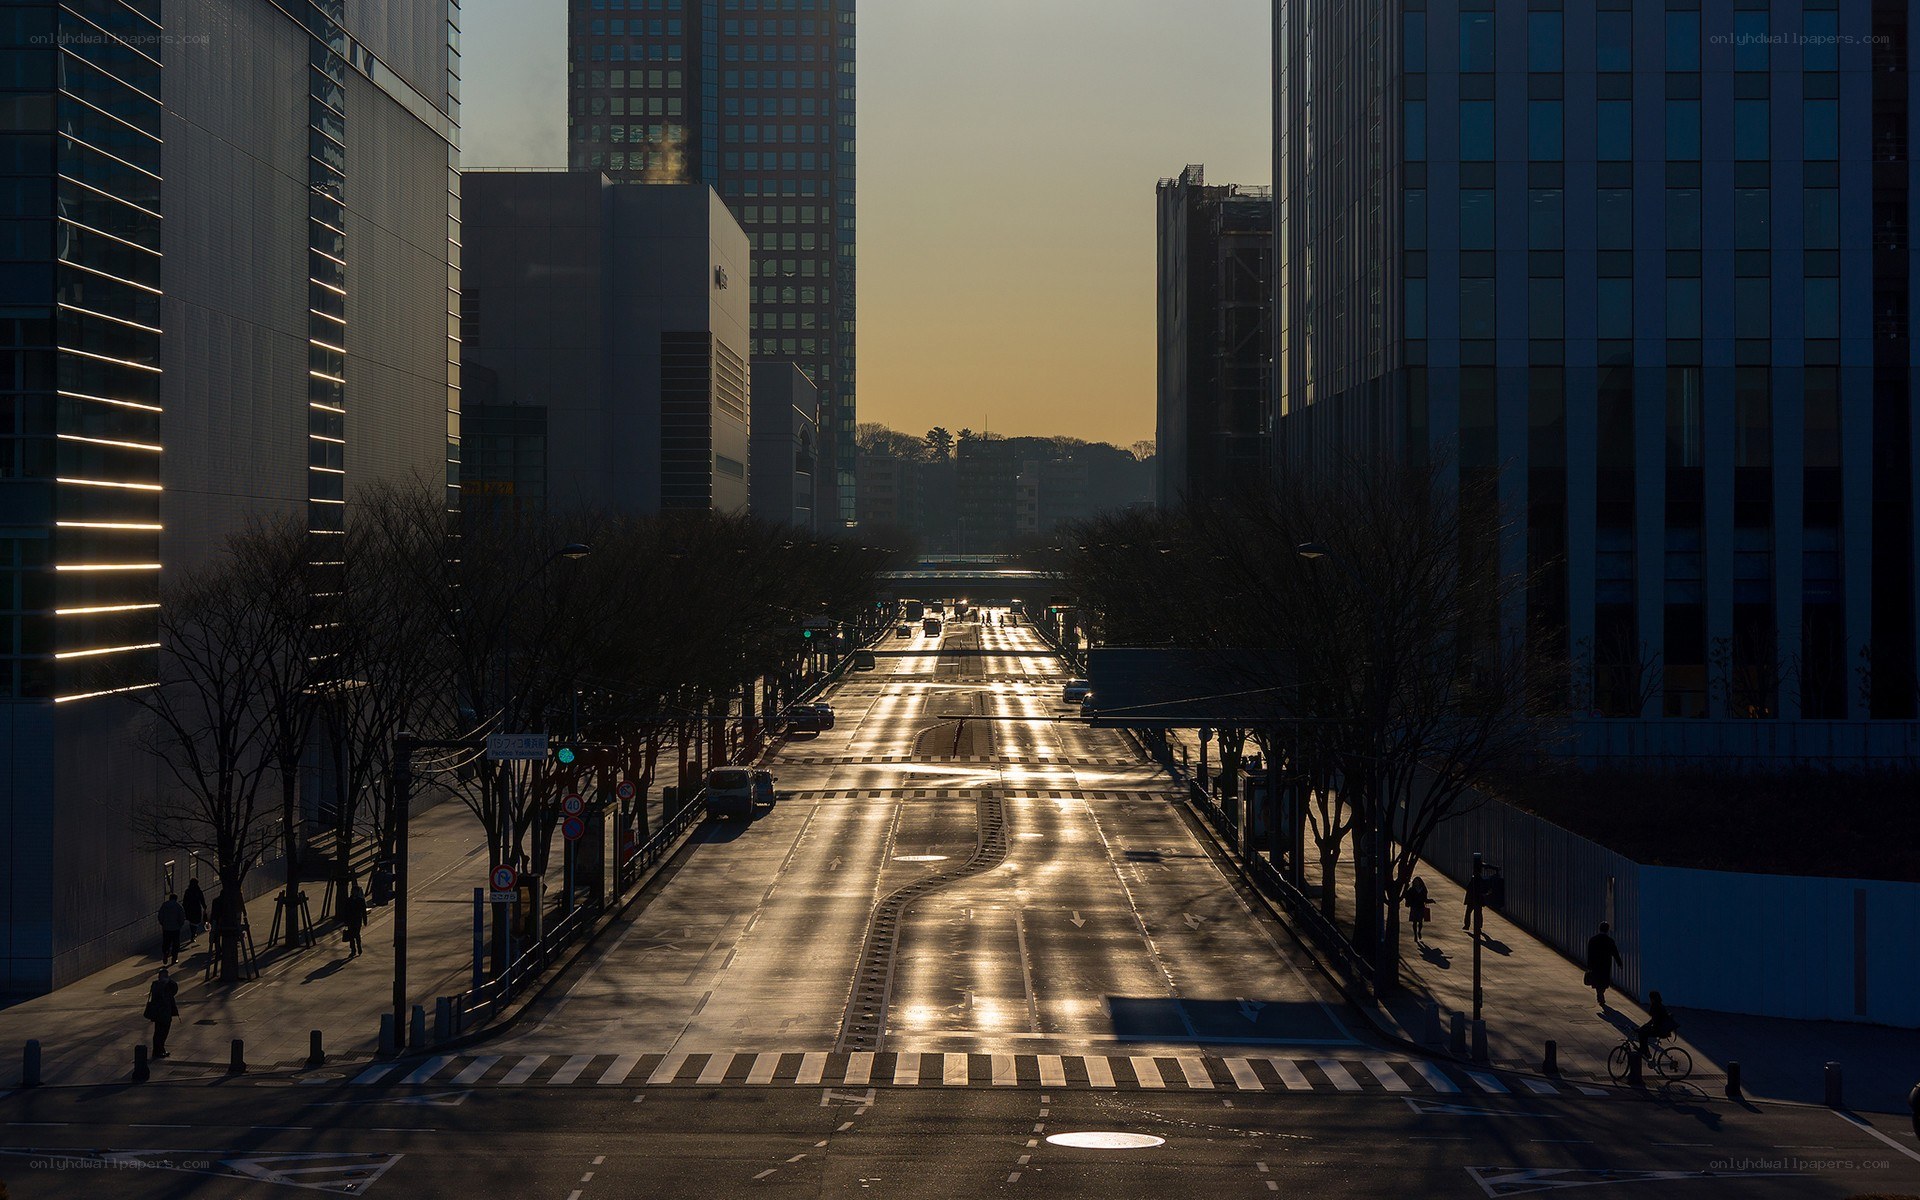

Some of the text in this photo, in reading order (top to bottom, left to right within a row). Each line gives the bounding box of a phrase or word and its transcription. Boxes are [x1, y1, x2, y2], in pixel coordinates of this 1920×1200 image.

[567, 800, 580, 811] 40
[491, 892, 516, 901] ここから
